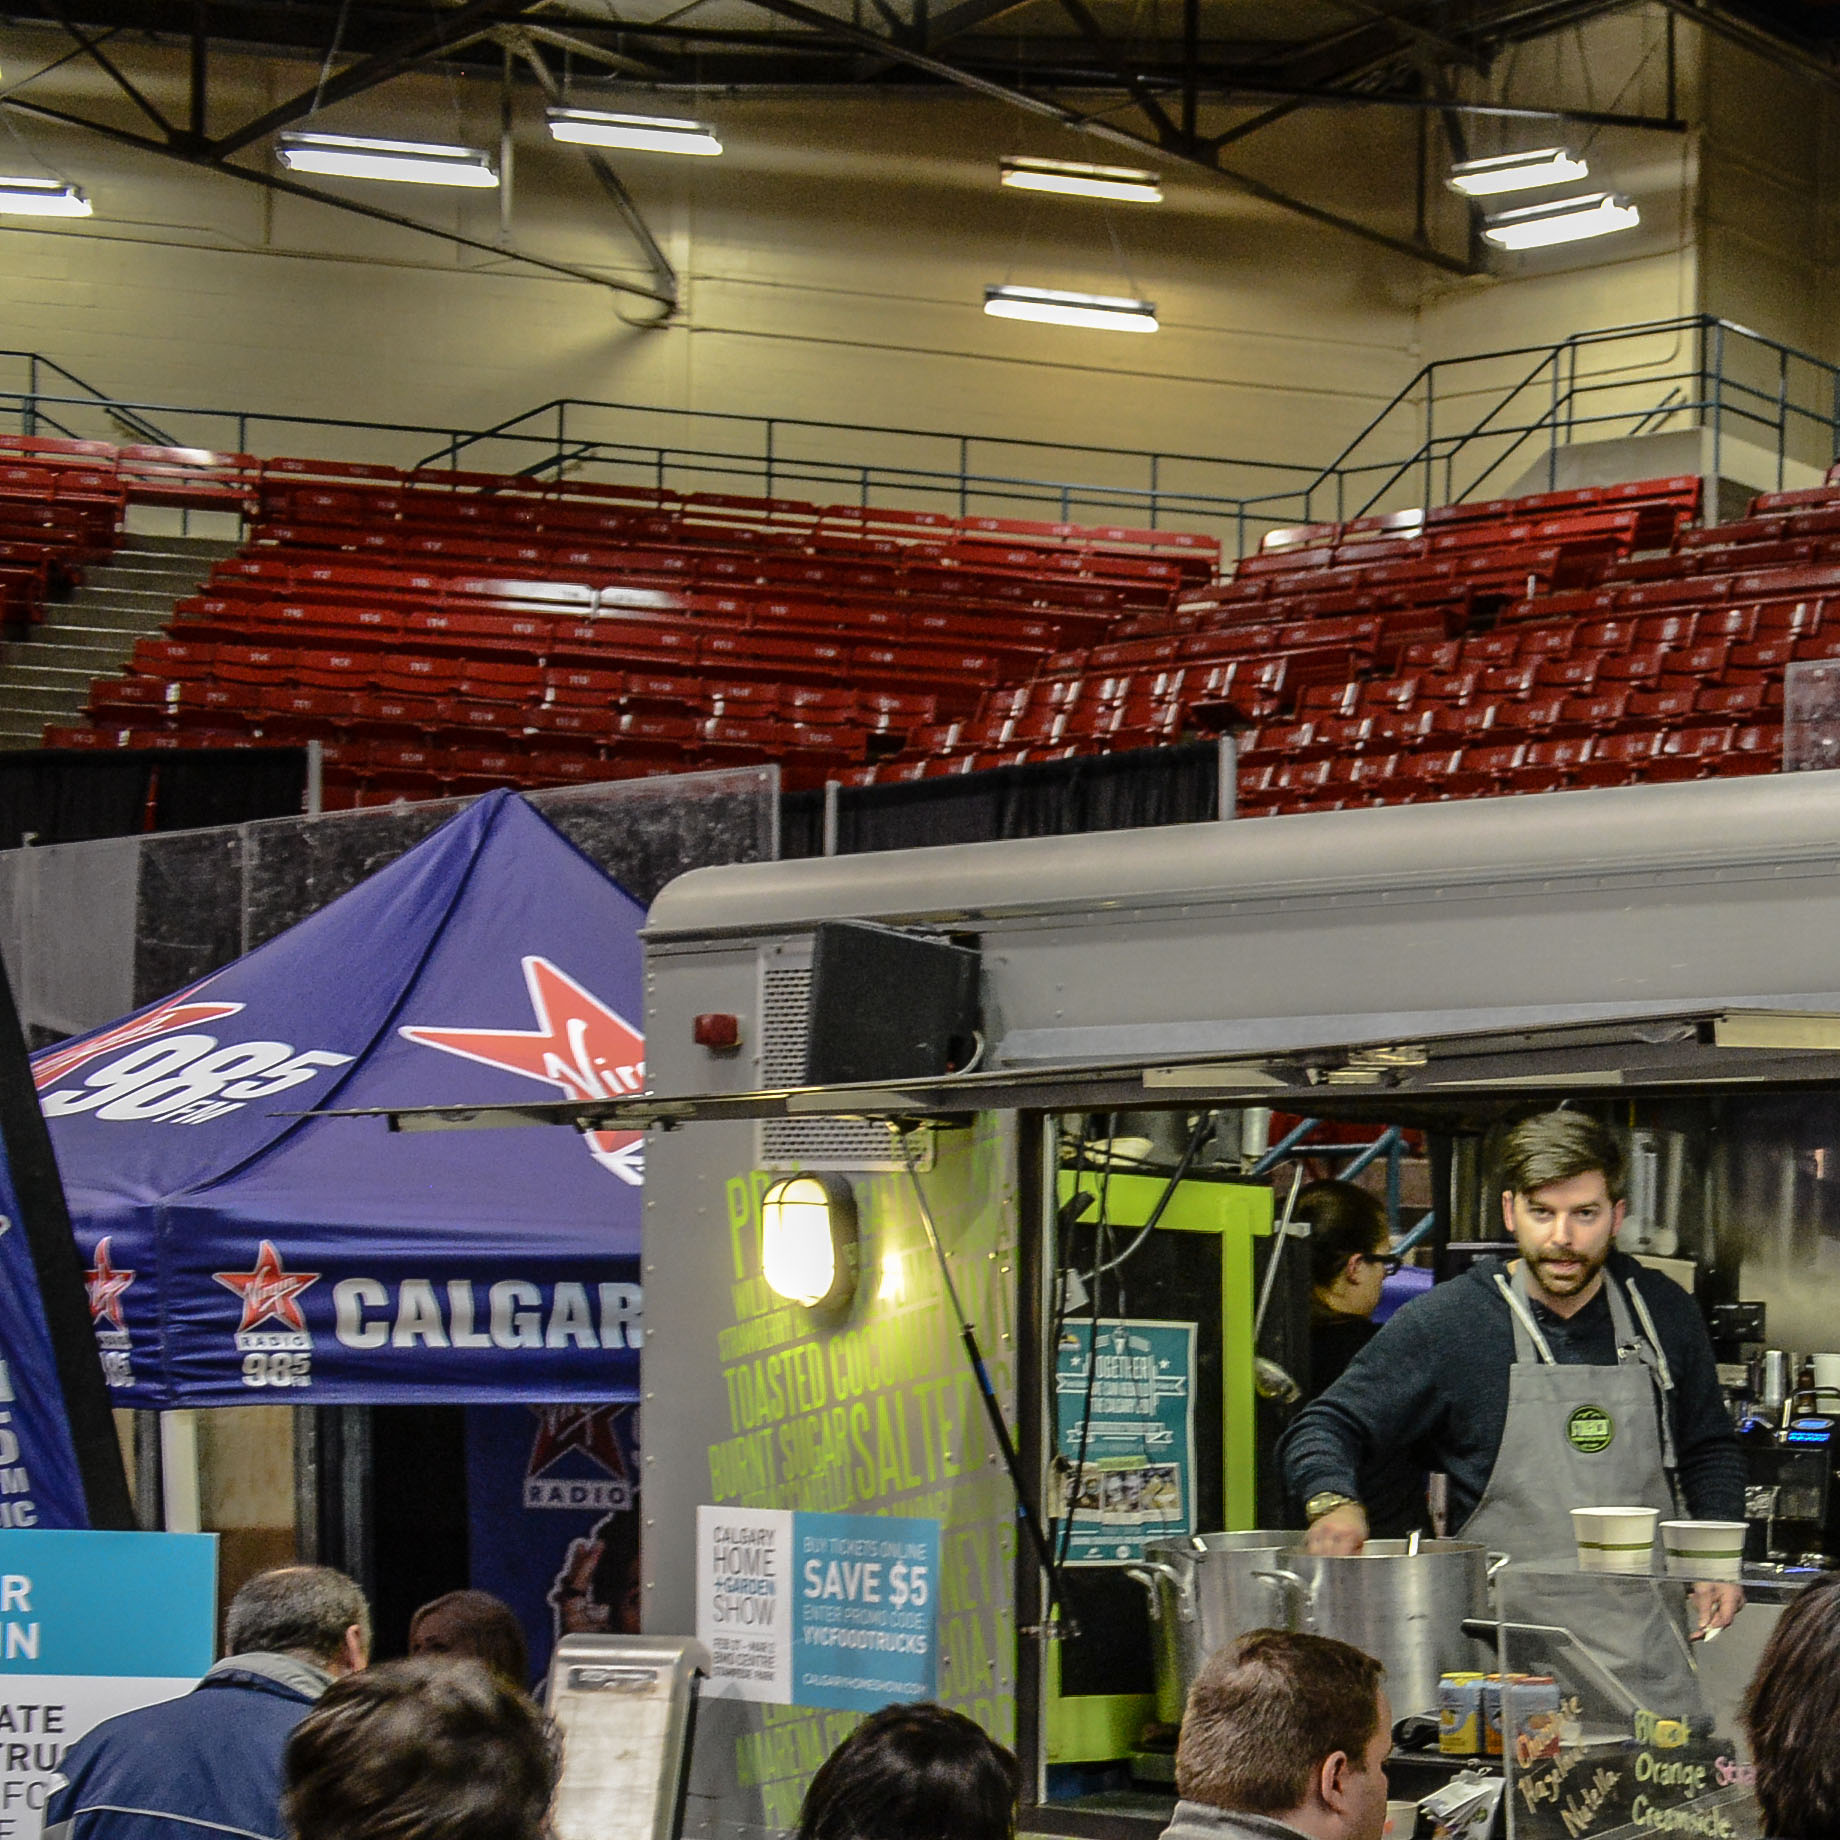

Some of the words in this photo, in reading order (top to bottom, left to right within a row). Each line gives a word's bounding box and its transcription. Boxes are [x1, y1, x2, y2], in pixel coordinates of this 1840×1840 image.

[722, 1341, 827, 1434] TOASTED
[779, 1405, 849, 1481] SUGAR
[850, 1370, 985, 1500] SALTED
[529, 1484, 628, 1507] RADIO
[712, 1525, 777, 1546] CALGARY
[803, 1536, 831, 1554] BUY
[831, 1538, 880, 1558] TICKETS
[880, 1540, 928, 1561] ONLINE
[712, 1547, 777, 1578] HOME
[714, 1577, 777, 1596] +GARDEN
[804, 1559, 883, 1605] SAVE
[888, 1560, 929, 1610] $5
[712, 1594, 776, 1625] SHOW
[803, 1604, 843, 1623] ENTER
[844, 1607, 887, 1626] PROMO
[803, 1626, 929, 1655] YYCFOODTRUCKS
[714, 1652, 735, 1667] BMO
[736, 1653, 776, 1669] CENTRE
[1634, 1751, 1707, 1800] Orange
